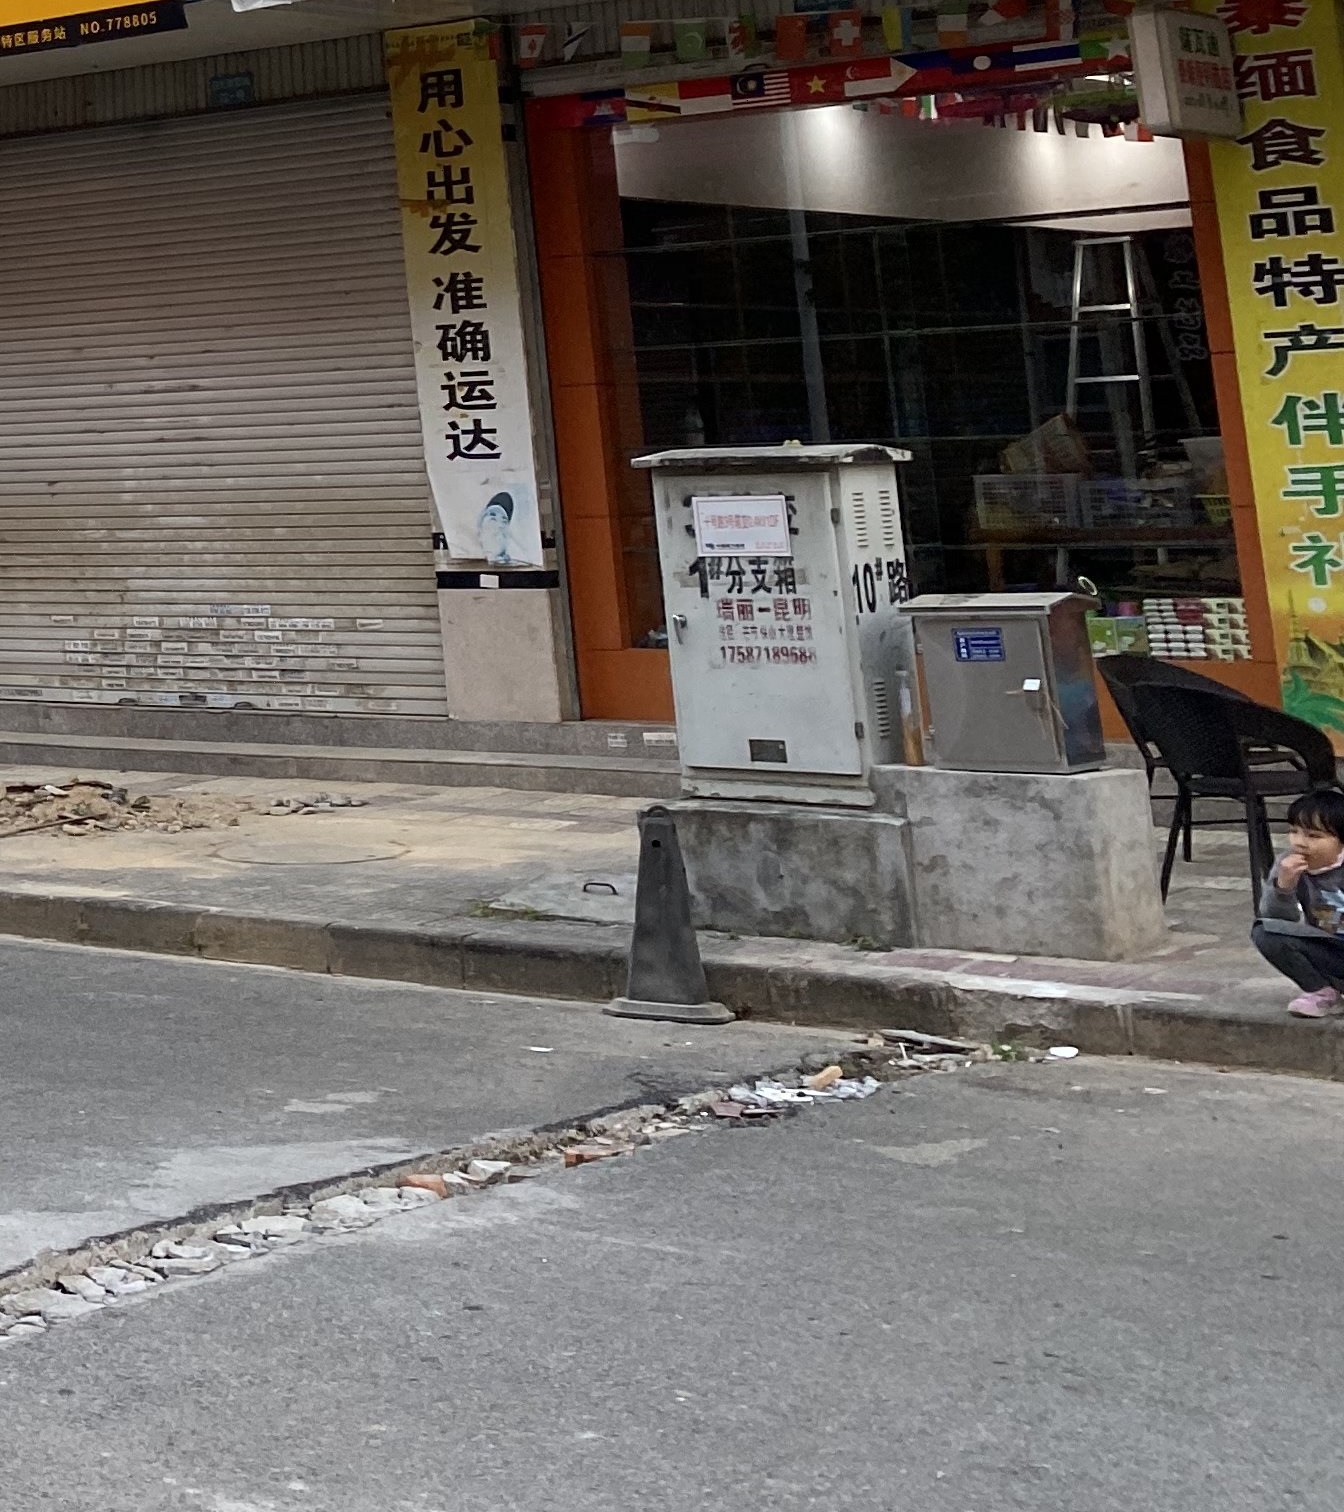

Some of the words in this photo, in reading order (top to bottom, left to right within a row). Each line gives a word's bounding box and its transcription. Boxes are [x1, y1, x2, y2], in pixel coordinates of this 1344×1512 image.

[416, 66, 482, 256] 用心出发
[431, 270, 503, 461] 准确运达
